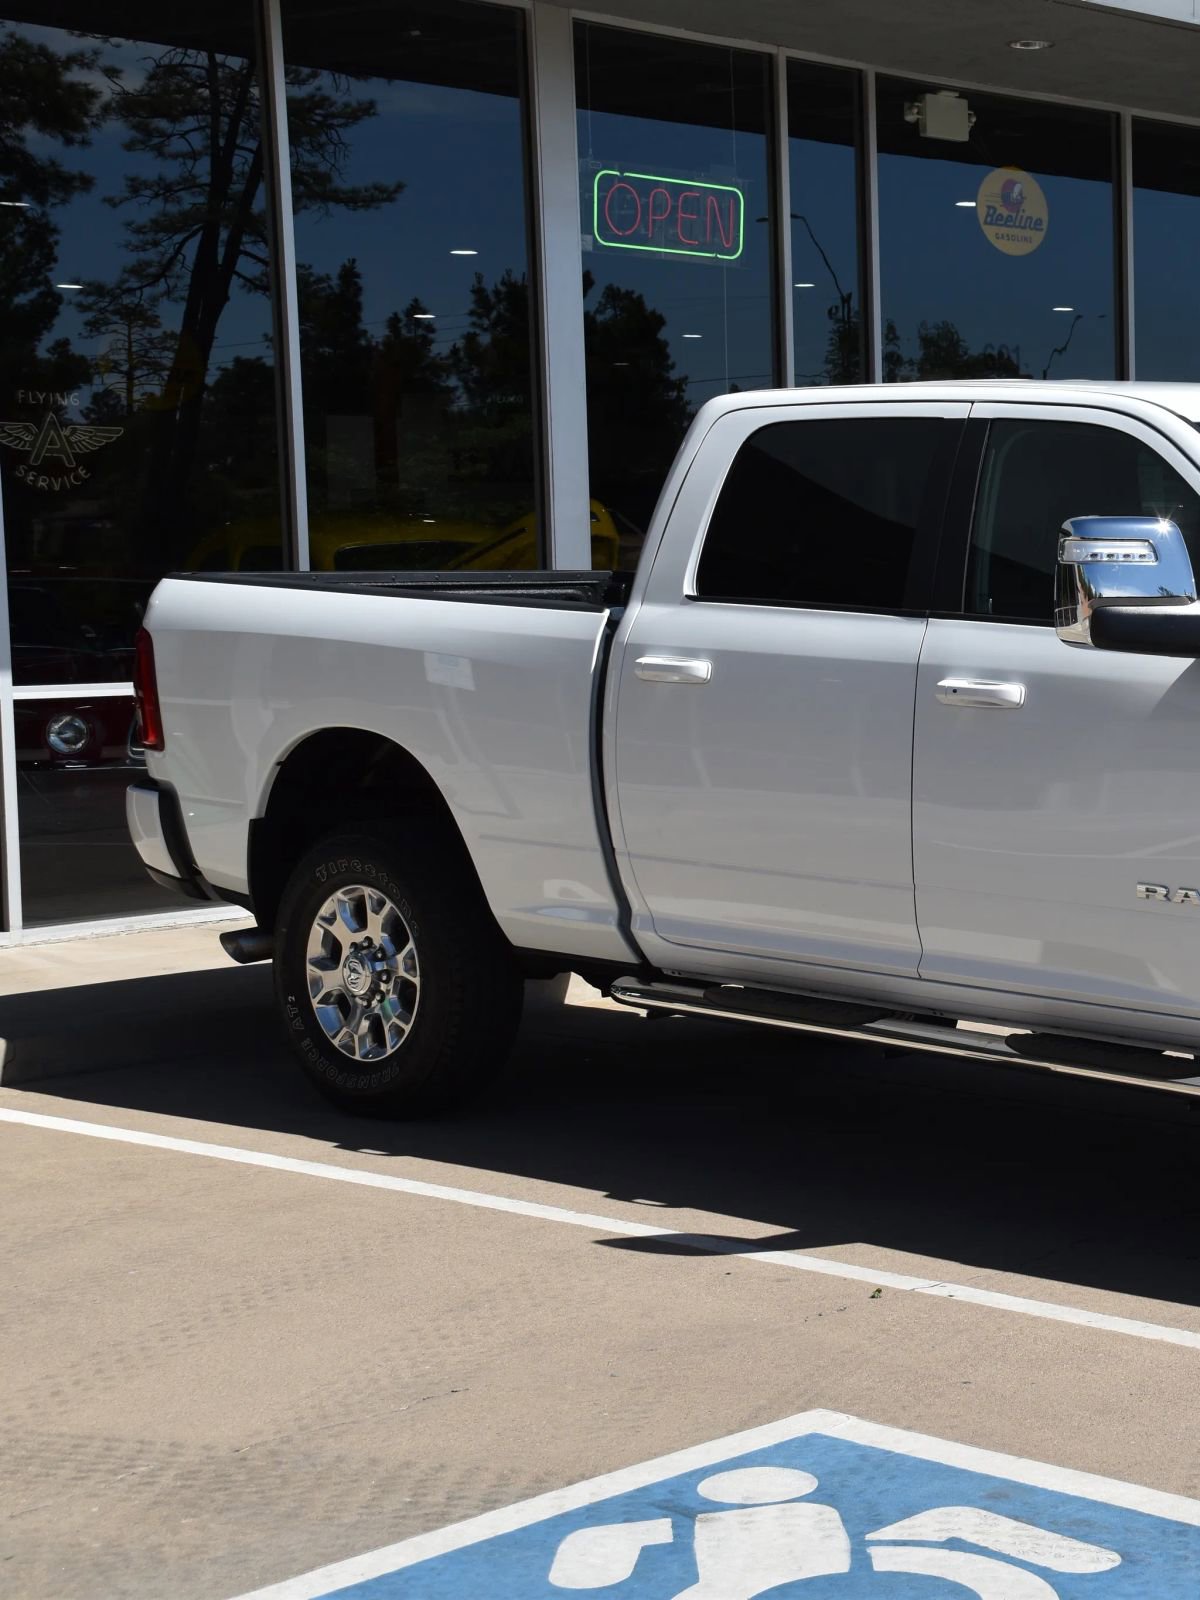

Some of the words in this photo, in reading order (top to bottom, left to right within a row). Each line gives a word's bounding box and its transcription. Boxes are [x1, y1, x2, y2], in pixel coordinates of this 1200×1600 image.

[604, 182, 735, 249] OPEN
[983, 204, 1044, 232] Beeline
[994, 232, 1033, 244] GASOLINE
[16, 389, 81, 406] FLYING
[15, 464, 92, 492] SERVICE
[314, 858, 421, 938] Firestone
